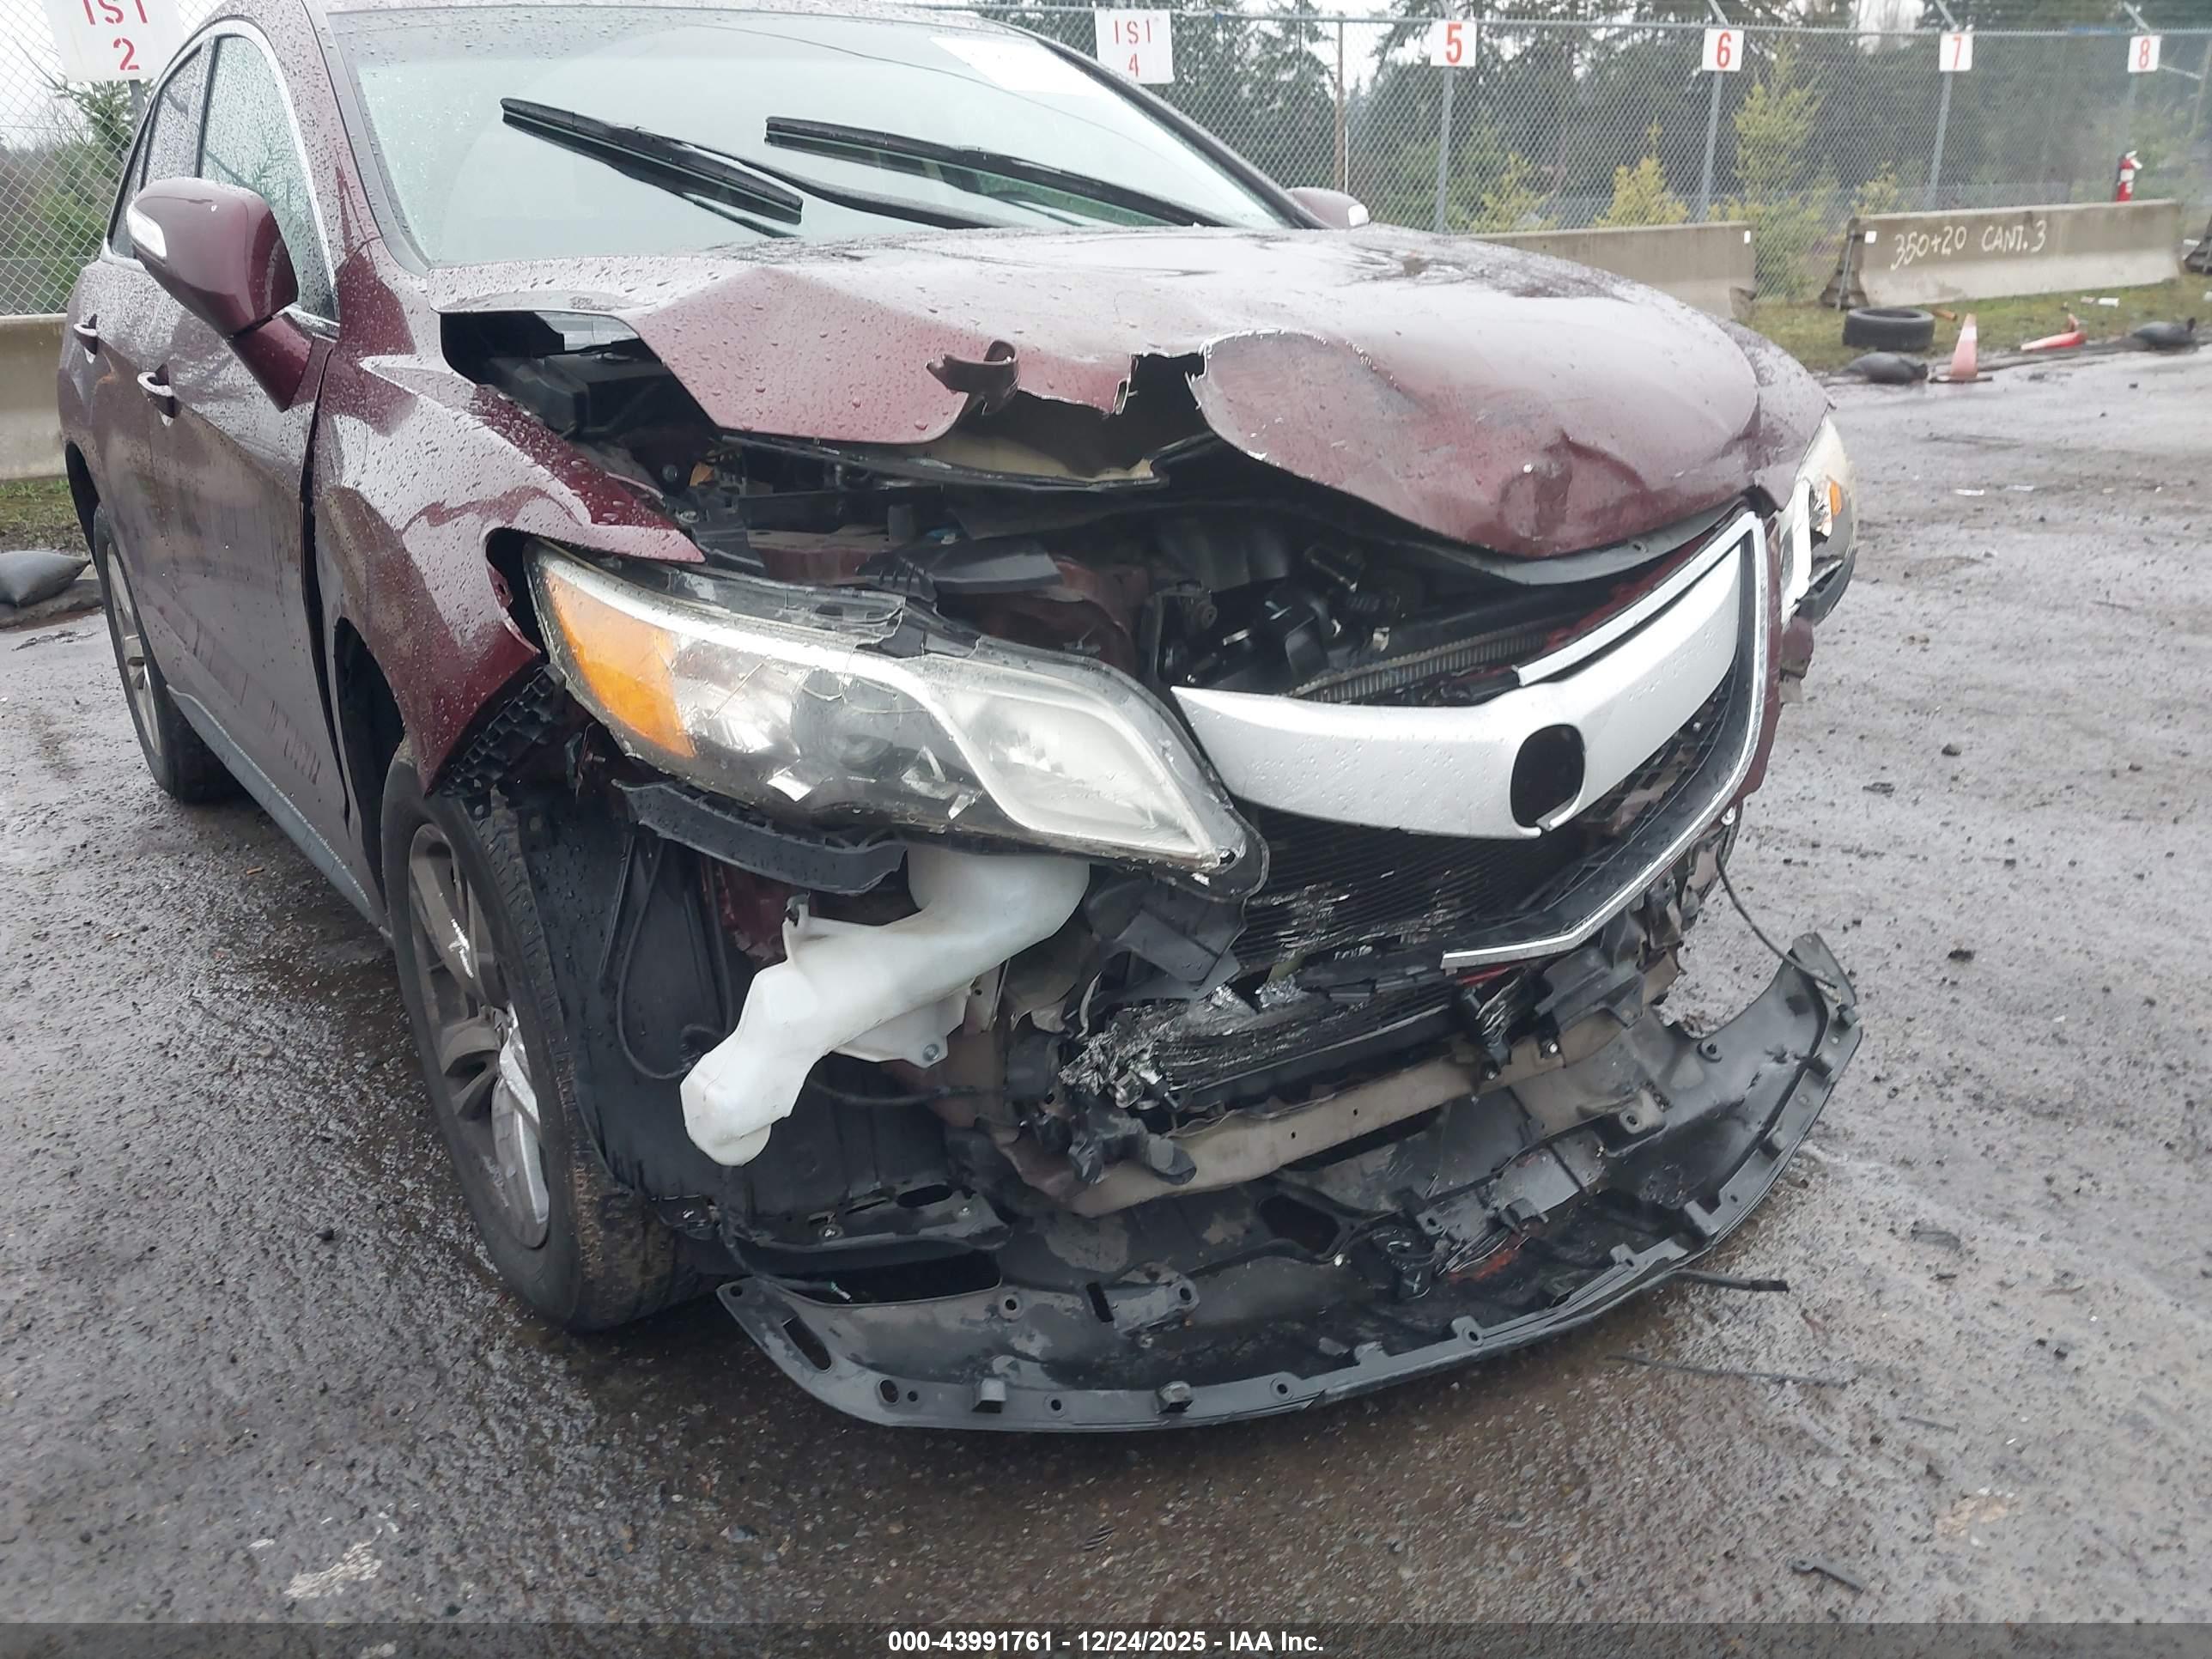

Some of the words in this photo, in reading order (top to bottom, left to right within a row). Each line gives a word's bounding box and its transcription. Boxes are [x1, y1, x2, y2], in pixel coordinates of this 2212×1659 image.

[113, 38, 139, 70] 2
[1446, 23, 1462, 64] 5
[1717, 32, 1731, 68] 6
[1953, 36, 1962, 69] 7
[2139, 40, 2150, 69] 8
[1128, 53, 1139, 77] 4
[1890, 225, 1967, 270] 350+20
